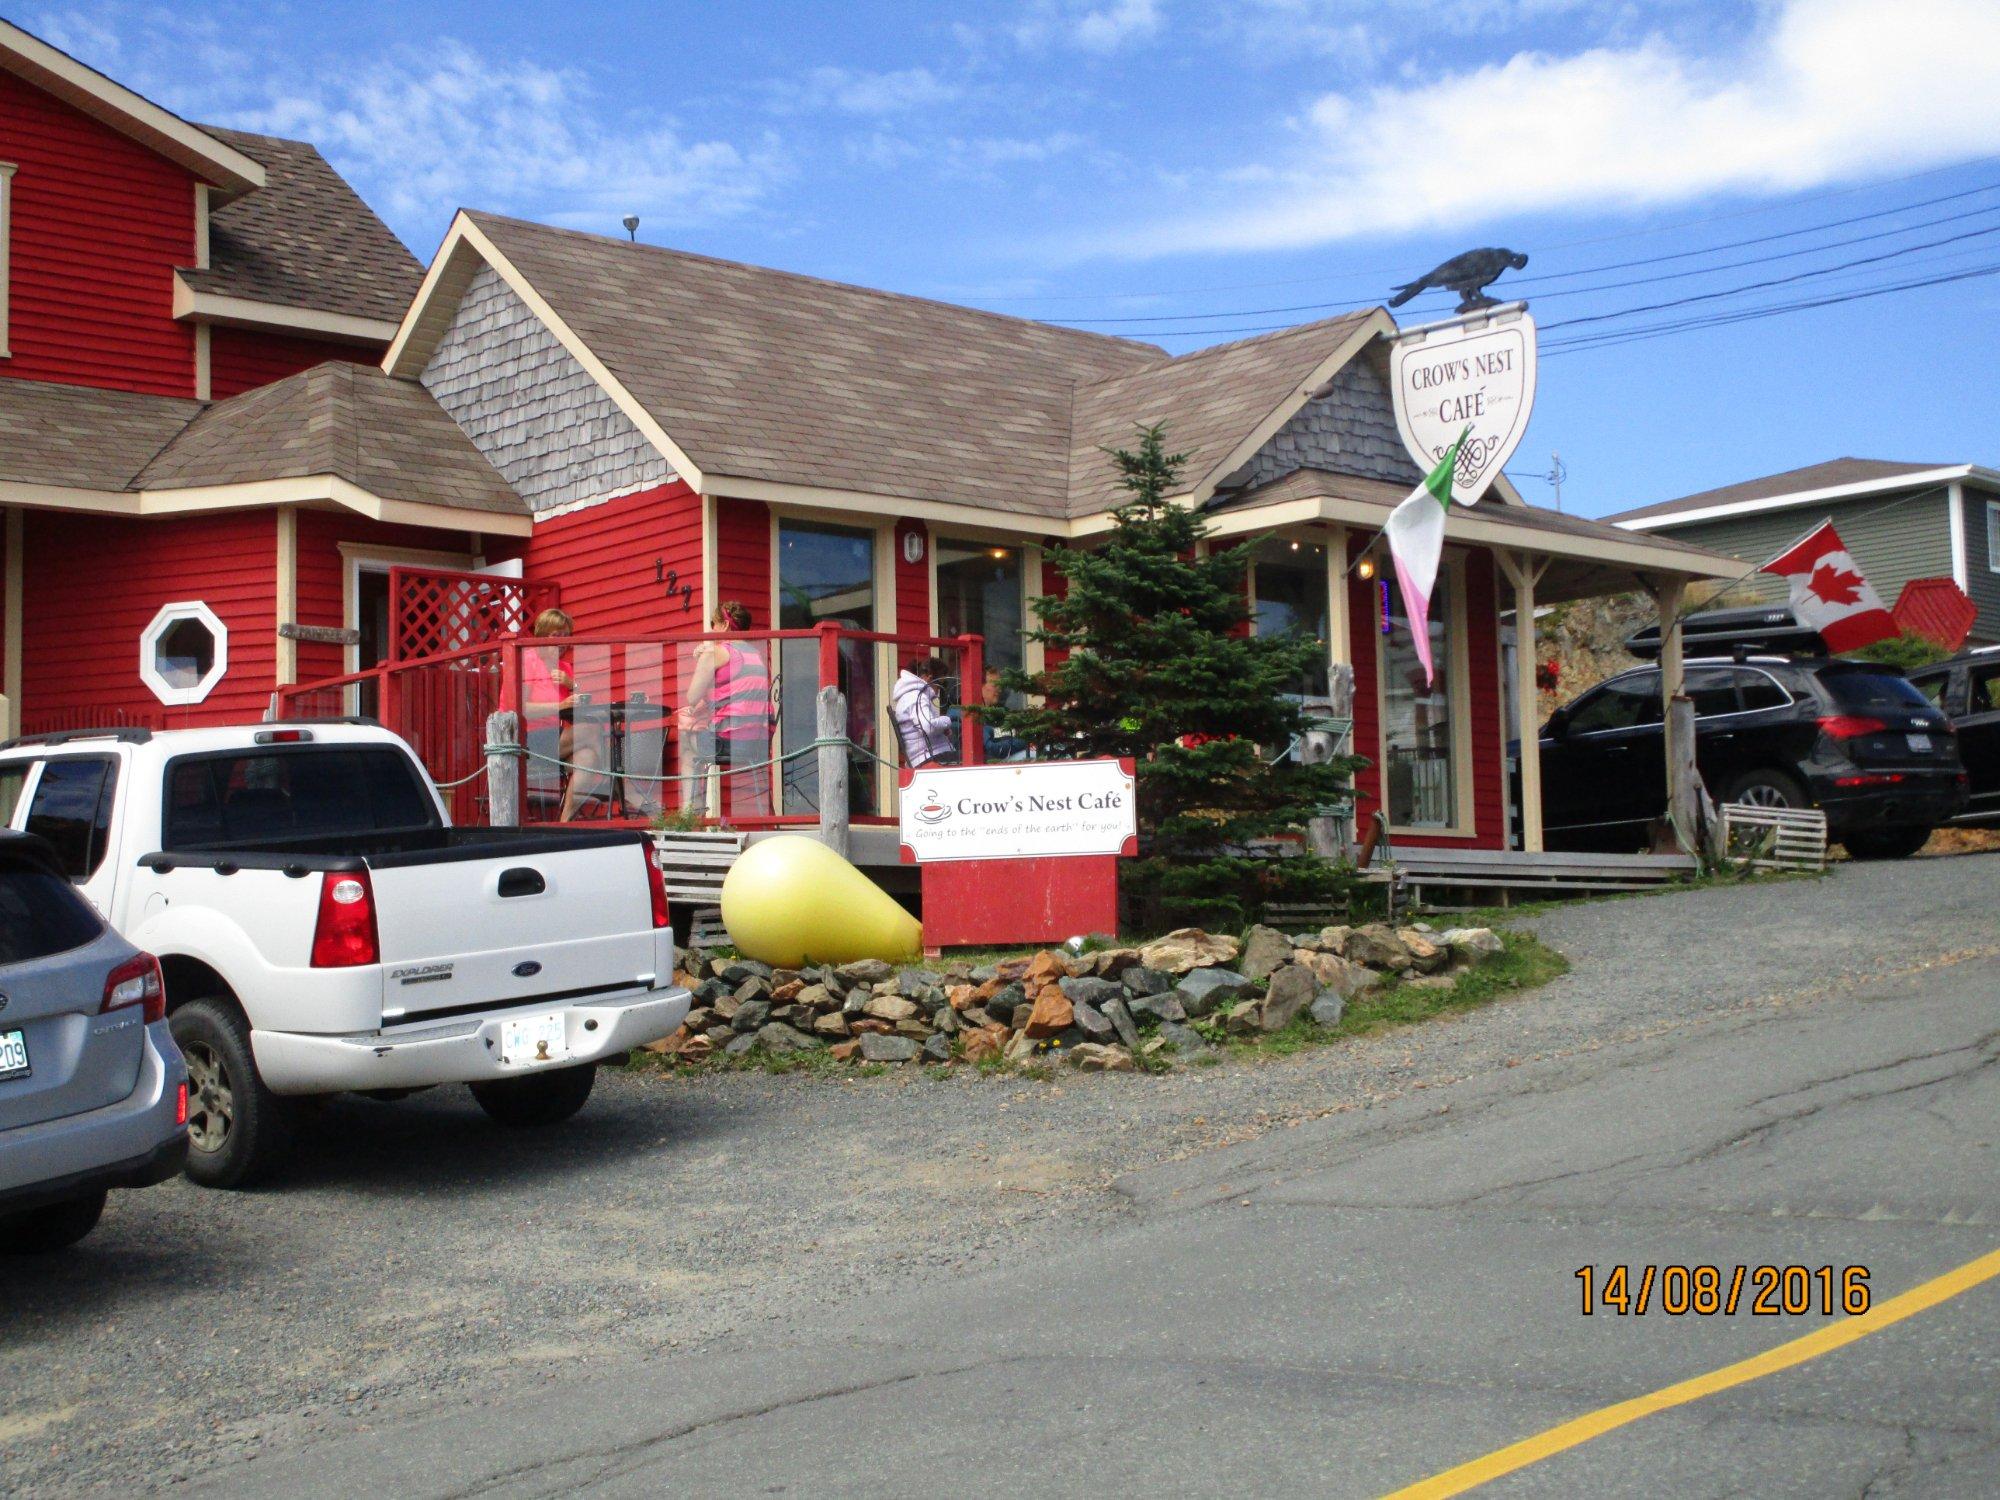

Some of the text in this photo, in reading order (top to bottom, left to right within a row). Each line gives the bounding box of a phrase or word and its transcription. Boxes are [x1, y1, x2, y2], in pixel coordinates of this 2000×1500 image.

[1412, 348, 1514, 391] CROW'S NEST
[1439, 385, 1487, 423] CAFÉ
[656, 557, 692, 613] 127
[957, 790, 1122, 815] Crow's Nest Café
[915, 829, 943, 840] Going
[947, 828, 957, 837] to
[960, 826, 977, 836] the
[1012, 824, 1023, 834] of
[1025, 823, 1041, 833] the
[1082, 820, 1097, 832] for
[390, 962, 454, 979] EXPLORER
